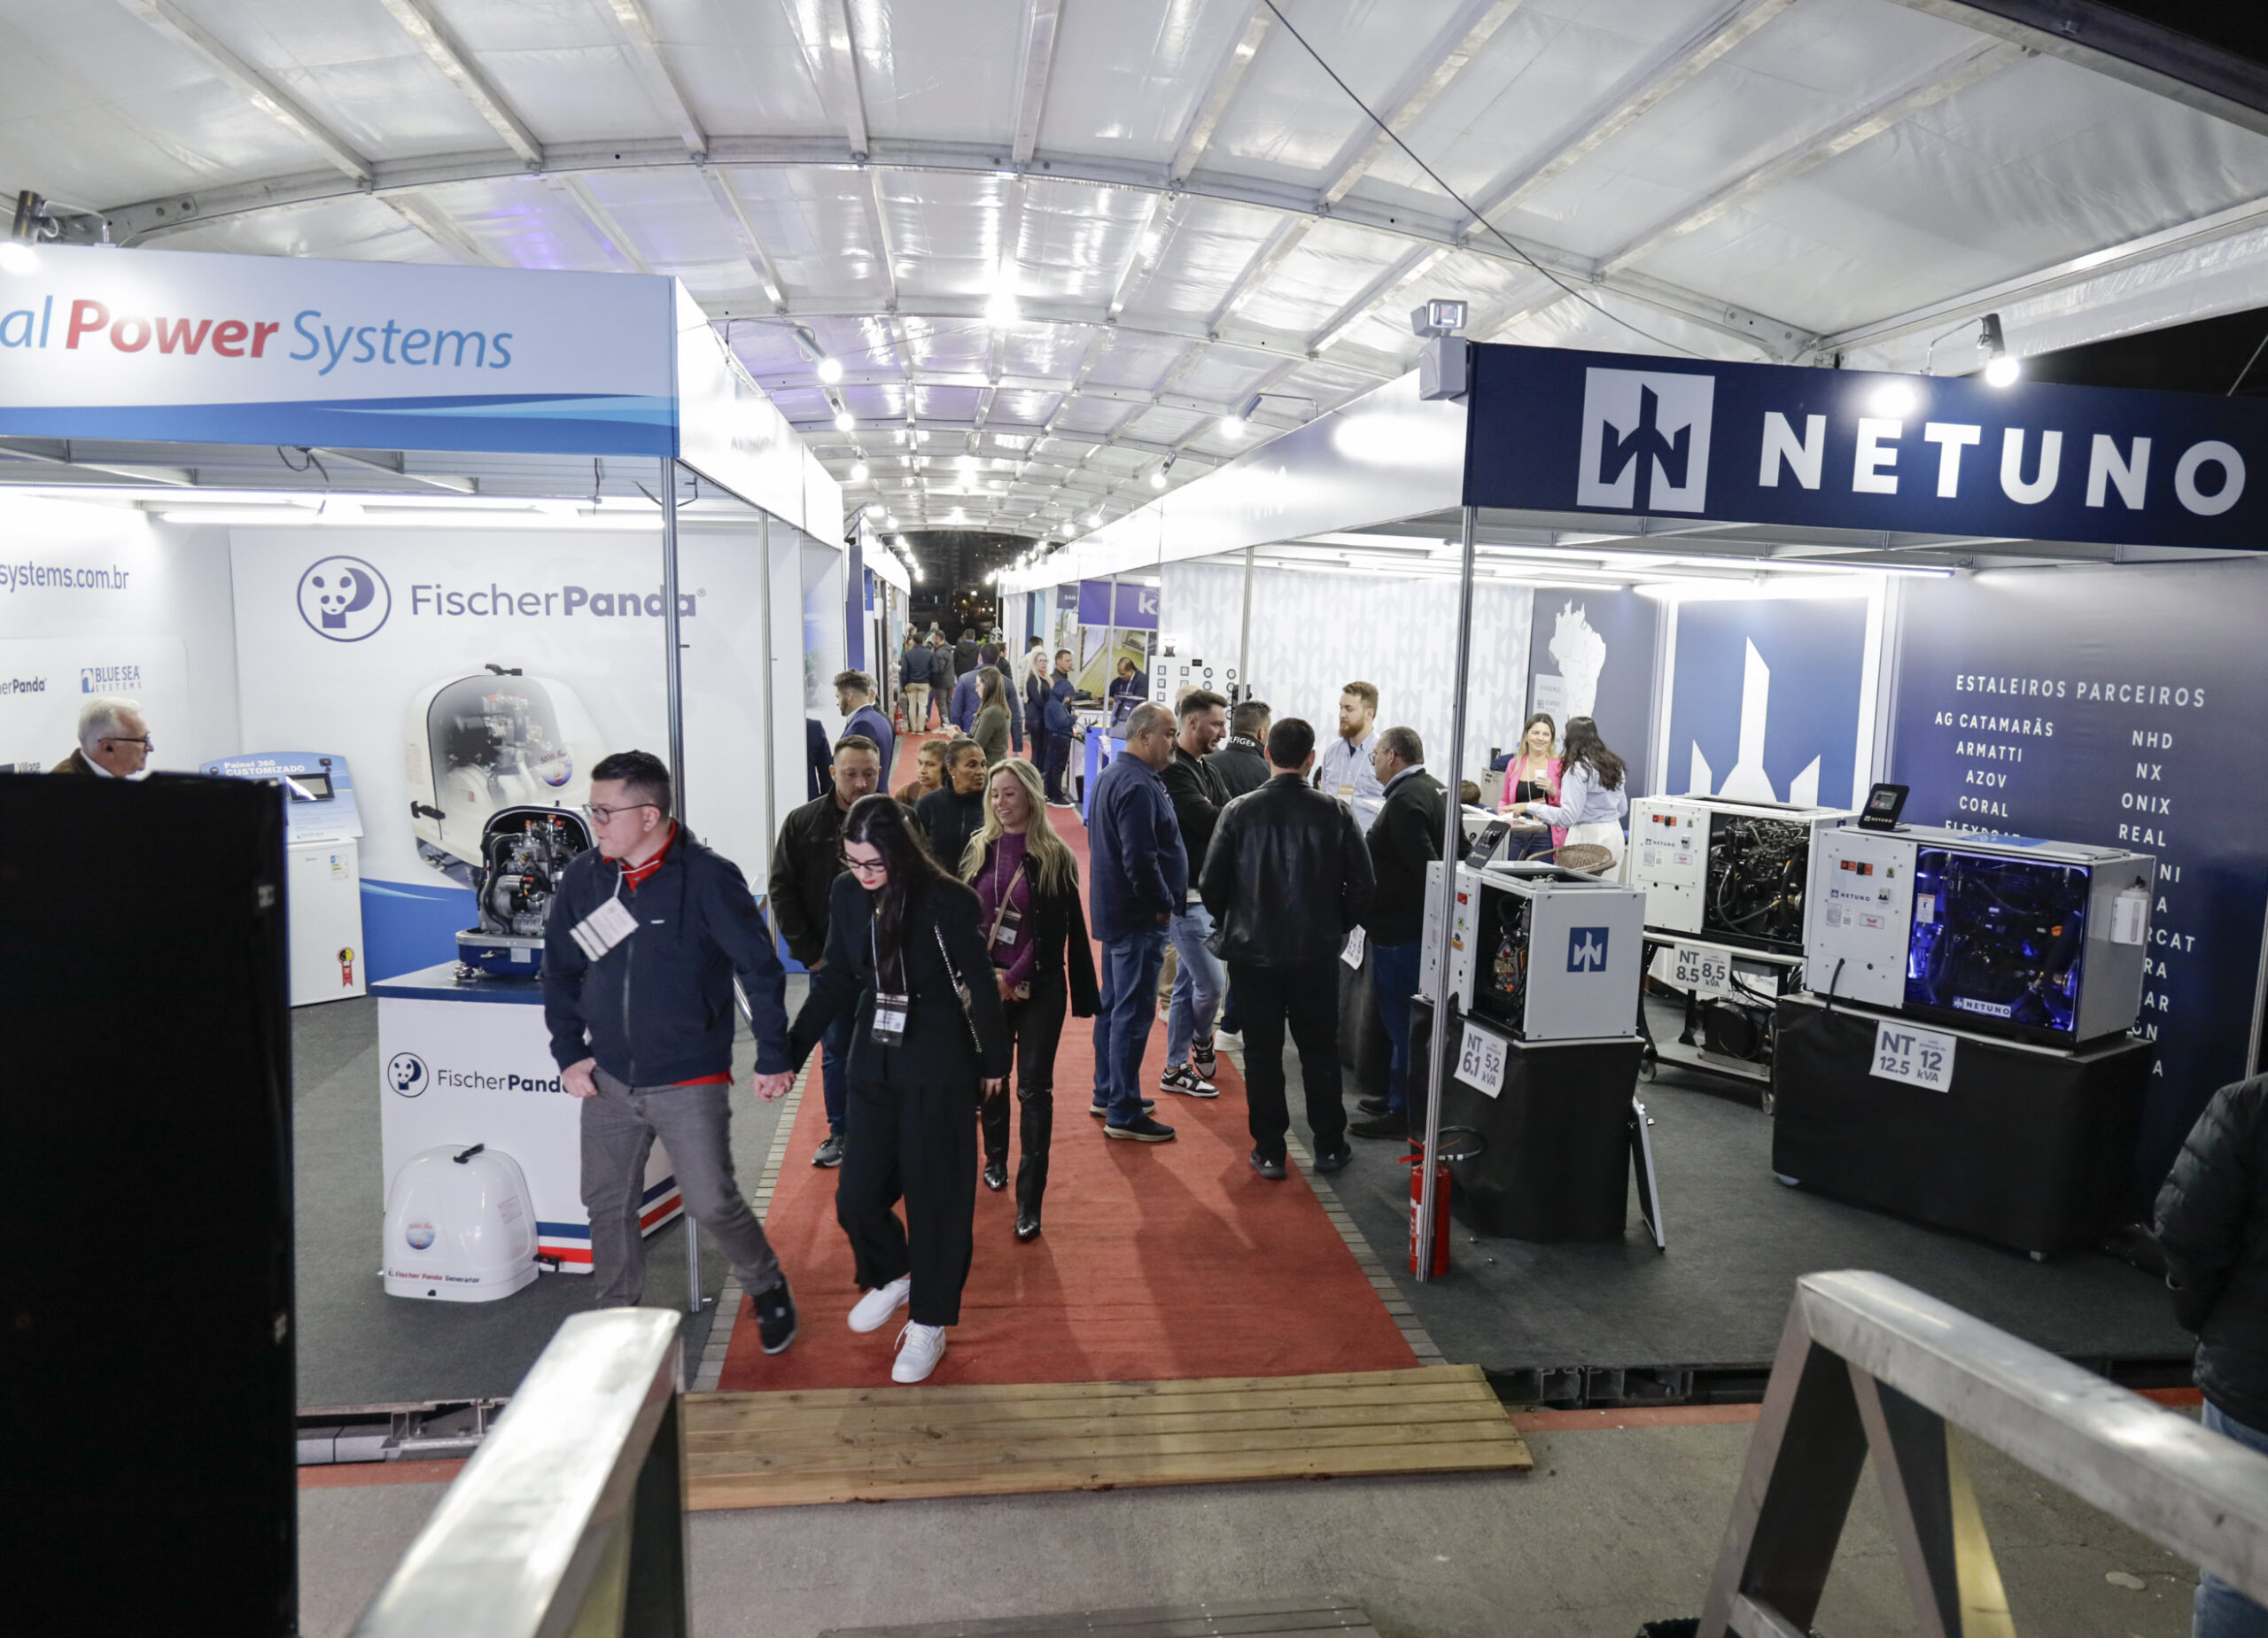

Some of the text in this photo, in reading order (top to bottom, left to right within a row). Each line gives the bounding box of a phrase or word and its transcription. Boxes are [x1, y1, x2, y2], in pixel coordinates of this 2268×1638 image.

[65, 299, 280, 359] Power
[290, 310, 514, 377] Systems
[1759, 410, 2247, 516] NETUNO
[95, 665, 141, 683] BLUE SEA
[95, 681, 143, 694] SYSTEMS
[1955, 674, 2206, 708] ESTALEIROS PARCEIROS
[1935, 711, 2054, 737] AG CATAMARÃS
[2132, 730, 2173, 749] NHD
[1955, 741, 2023, 763] ARMATTI
[225, 765, 306, 776] CUSTOMIZADO
[1965, 769, 2008, 789] AZOV
[2136, 763, 2163, 781] NX
[1959, 796, 2008, 818] CORAL
[2121, 793, 2171, 816] ONIX
[2118, 824, 2167, 848] REAL
[1840, 892, 1871, 902] NETUNO
[1679, 950, 1700, 965] NT
[1675, 966, 1699, 983] 8.5
[1702, 962, 1726, 982] 8,5
[1705, 979, 1720, 989] kVA
[1965, 1001, 2010, 1016] NETUNO
[1467, 1032, 1483, 1053] NT
[1881, 1030, 1916, 1056] NT
[1463, 1051, 1481, 1077] 6.1
[1485, 1052, 1500, 1074] 5,2
[1880, 1056, 1911, 1075] 12.5
[1920, 1050, 1943, 1072] 12
[438, 1068, 569, 1094] FischerPand
[1481, 1070, 1496, 1088] kVA
[1916, 1068, 1938, 1083] kVA
[445, 1274, 481, 1284] Generator
